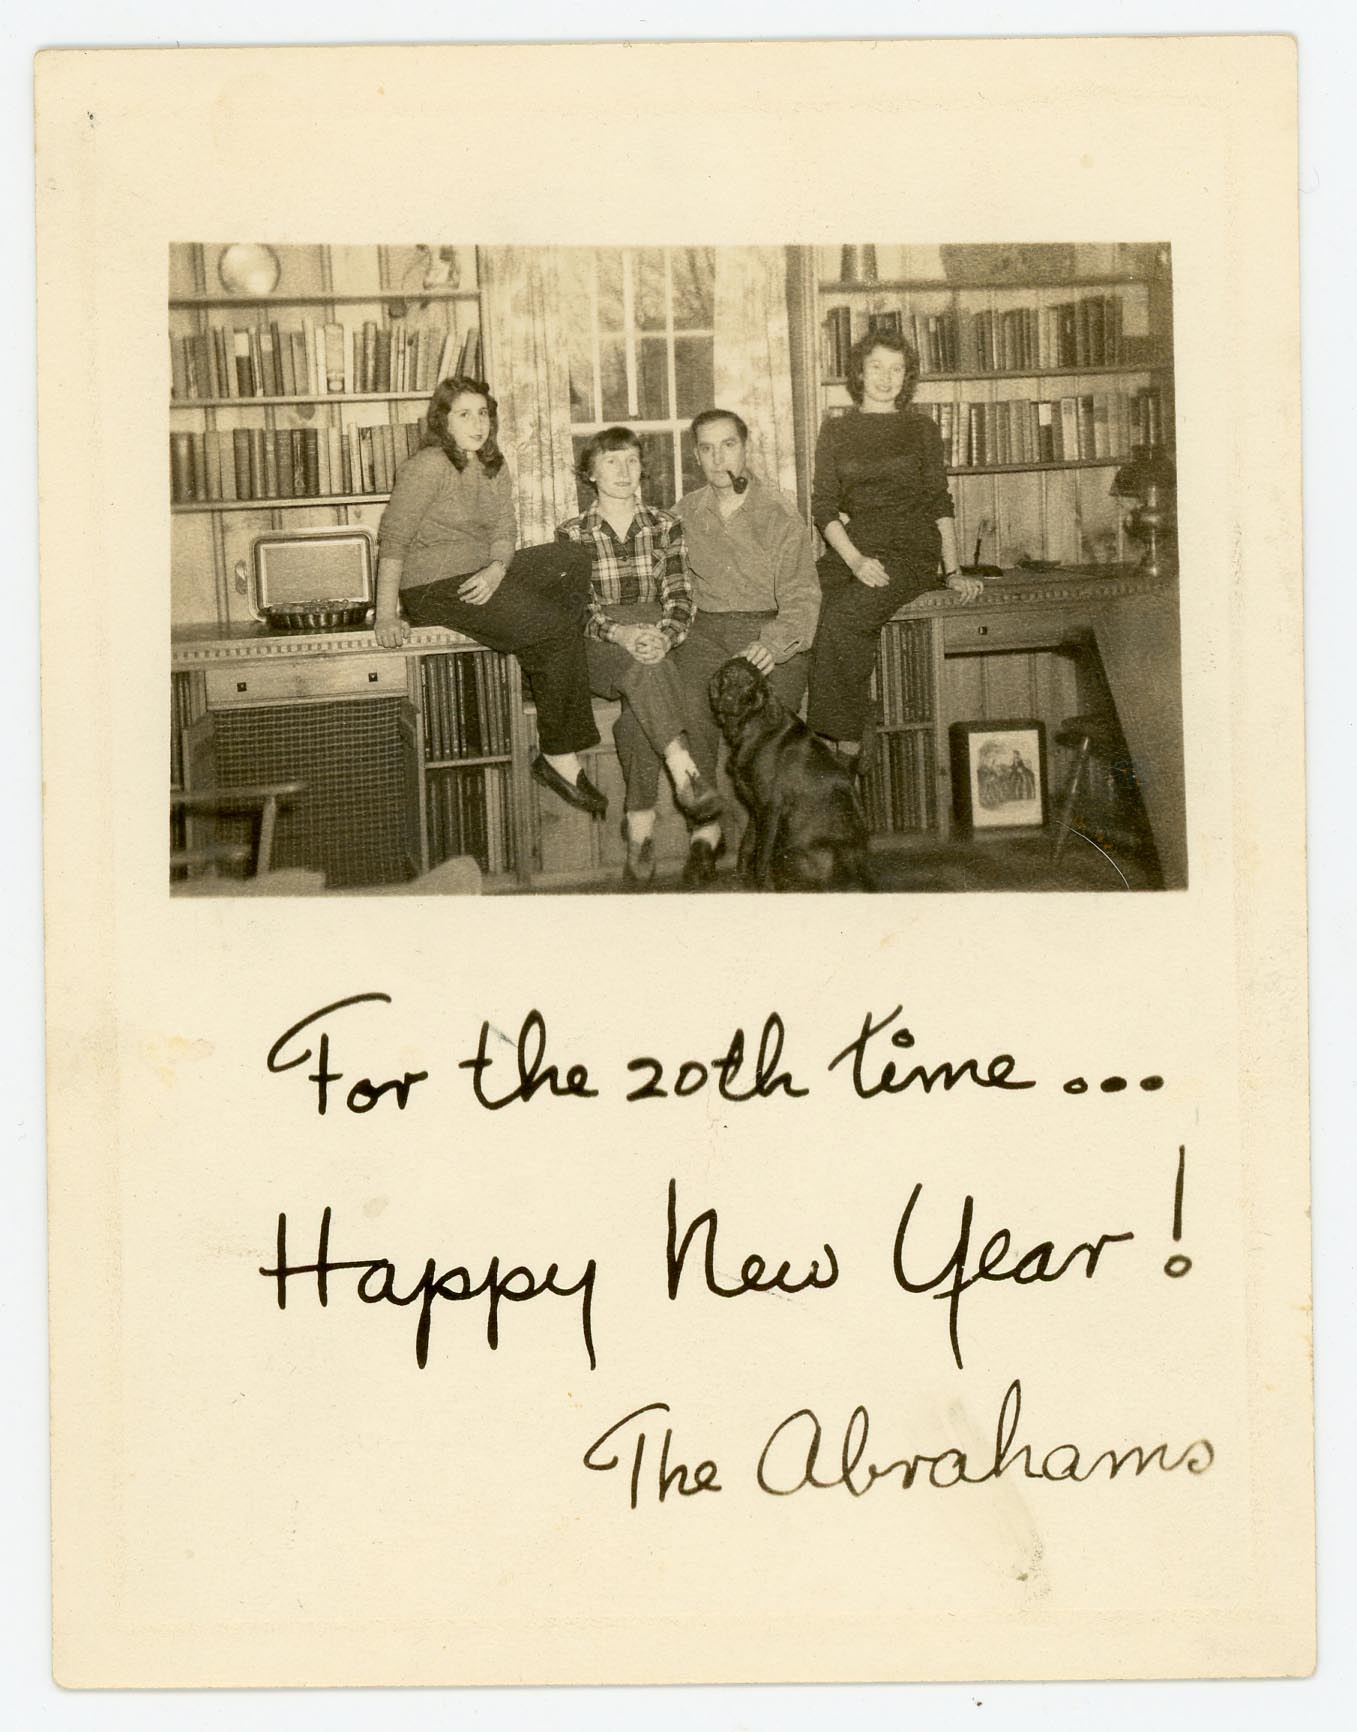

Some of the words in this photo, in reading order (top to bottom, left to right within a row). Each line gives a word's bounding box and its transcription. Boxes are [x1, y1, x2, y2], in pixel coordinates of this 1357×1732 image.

[267, 993, 428, 1115] For
[459, 1010, 598, 1110] the
[627, 1012, 809, 1101] 20th
[259, 1207, 596, 1370] Happy
[667, 1179, 838, 1300] New
[584, 1403, 721, 1509] The
[757, 1379, 1214, 1496] Abrahams
